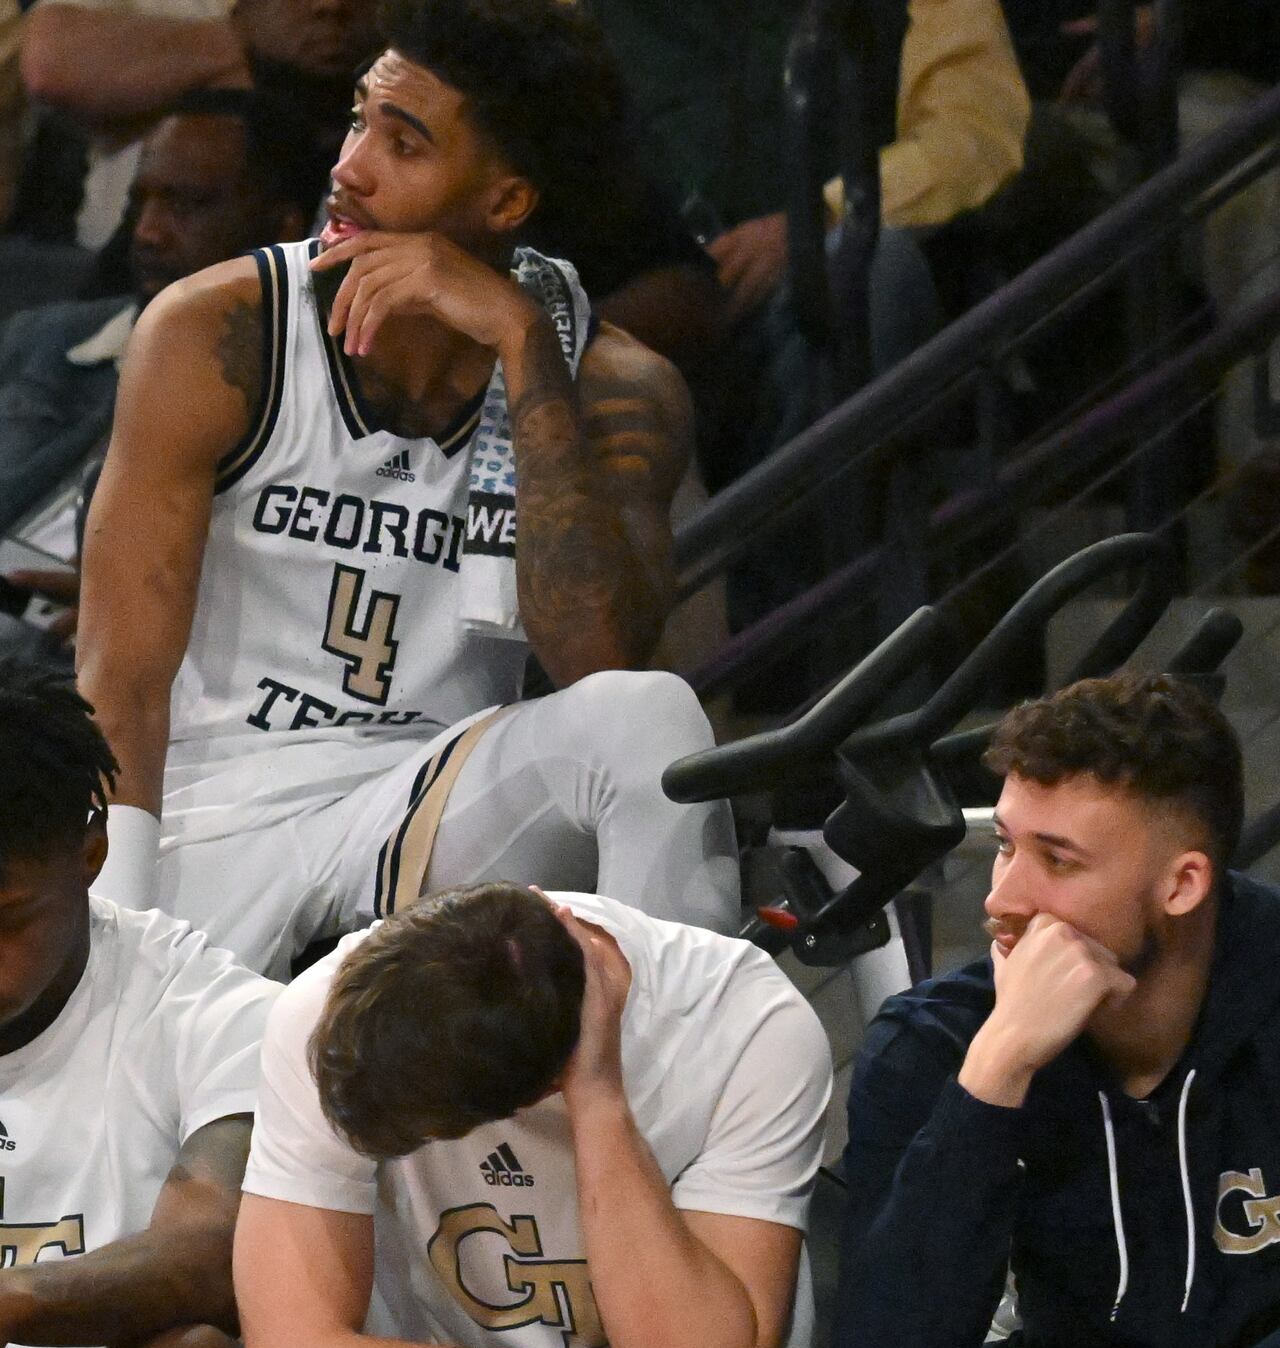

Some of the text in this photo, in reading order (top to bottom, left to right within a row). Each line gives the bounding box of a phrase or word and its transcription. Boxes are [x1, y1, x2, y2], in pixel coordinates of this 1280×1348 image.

[376, 465, 415, 483] adidas
[252, 485, 465, 573] GEORGI
[321, 562, 402, 706] 4
[481, 1171, 535, 1187] didas
